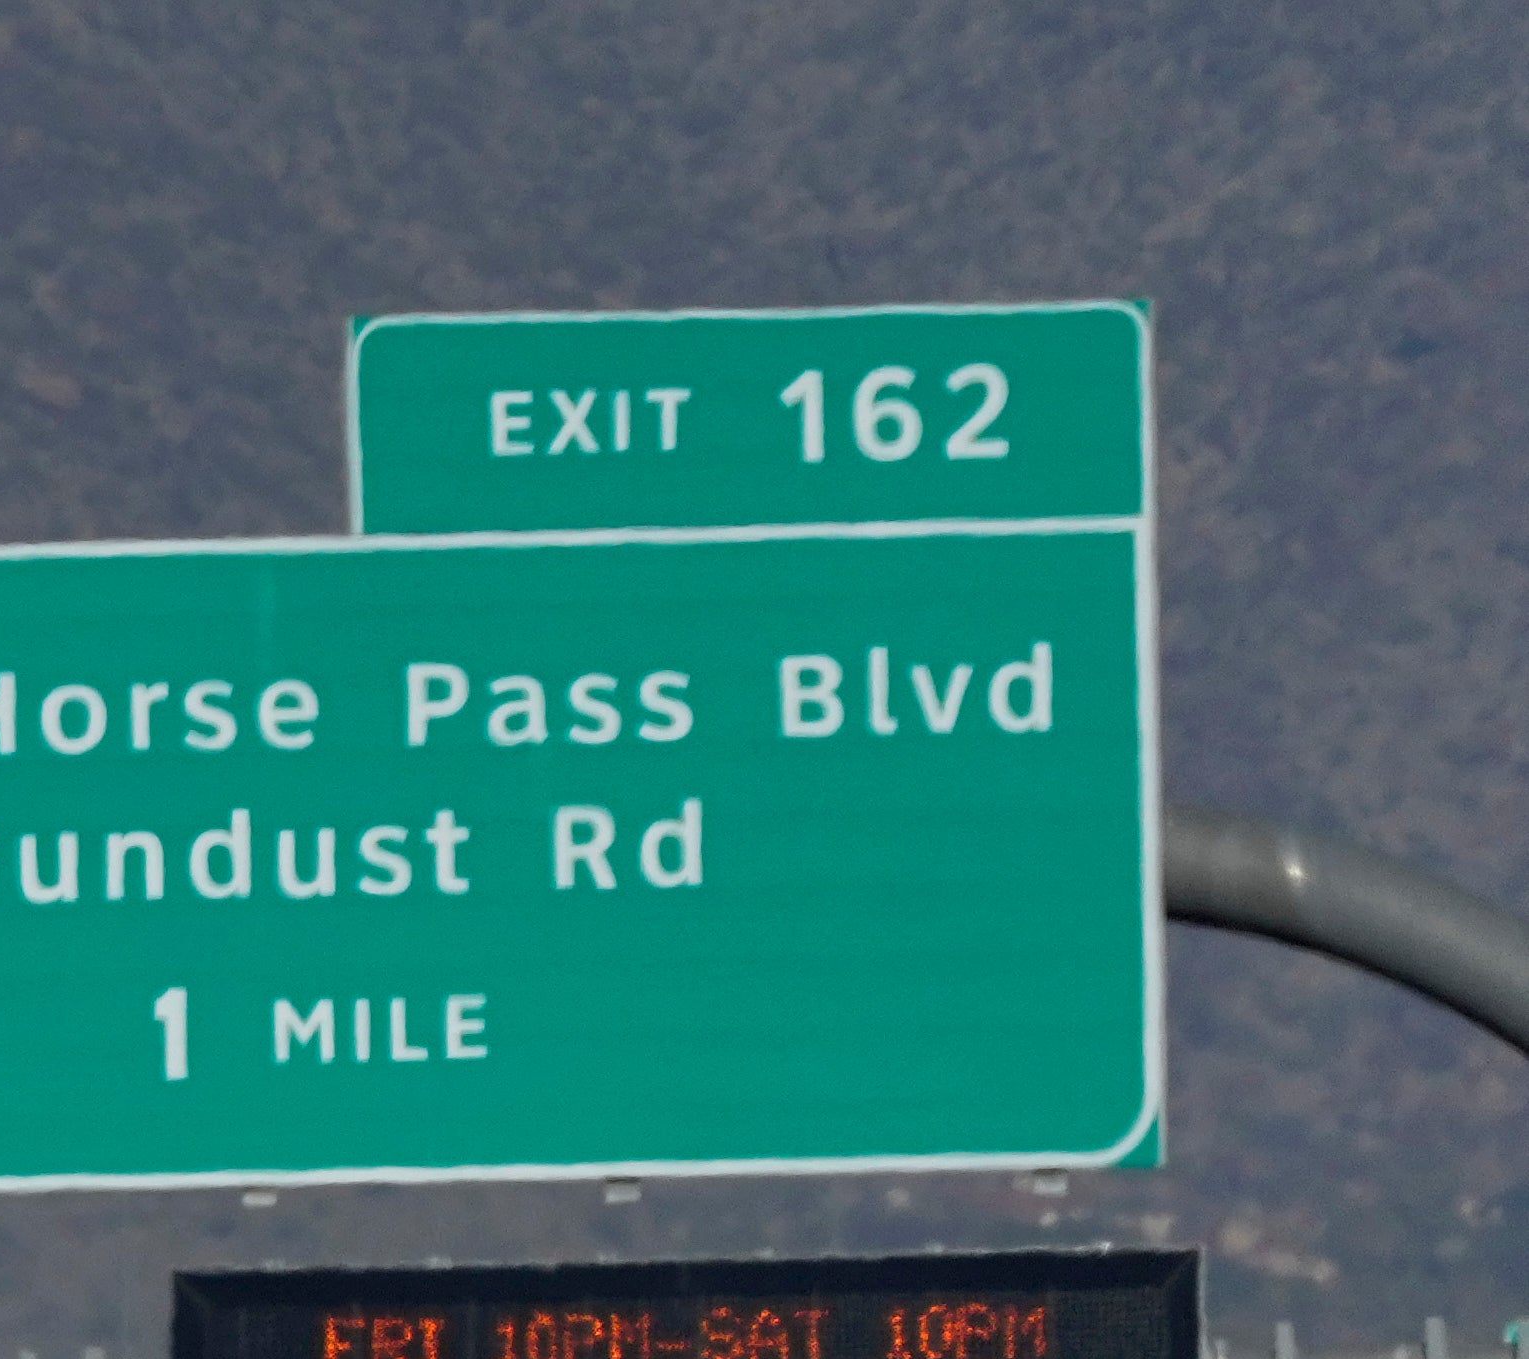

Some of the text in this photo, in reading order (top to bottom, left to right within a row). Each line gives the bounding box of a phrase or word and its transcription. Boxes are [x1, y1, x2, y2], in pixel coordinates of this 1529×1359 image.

[490, 362, 1011, 464] EXIT 162
[405, 661, 695, 748] Pass
[779, 641, 1055, 739] Blvd
[553, 797, 704, 891] Rd
[152, 986, 489, 1081] 1 MILE
